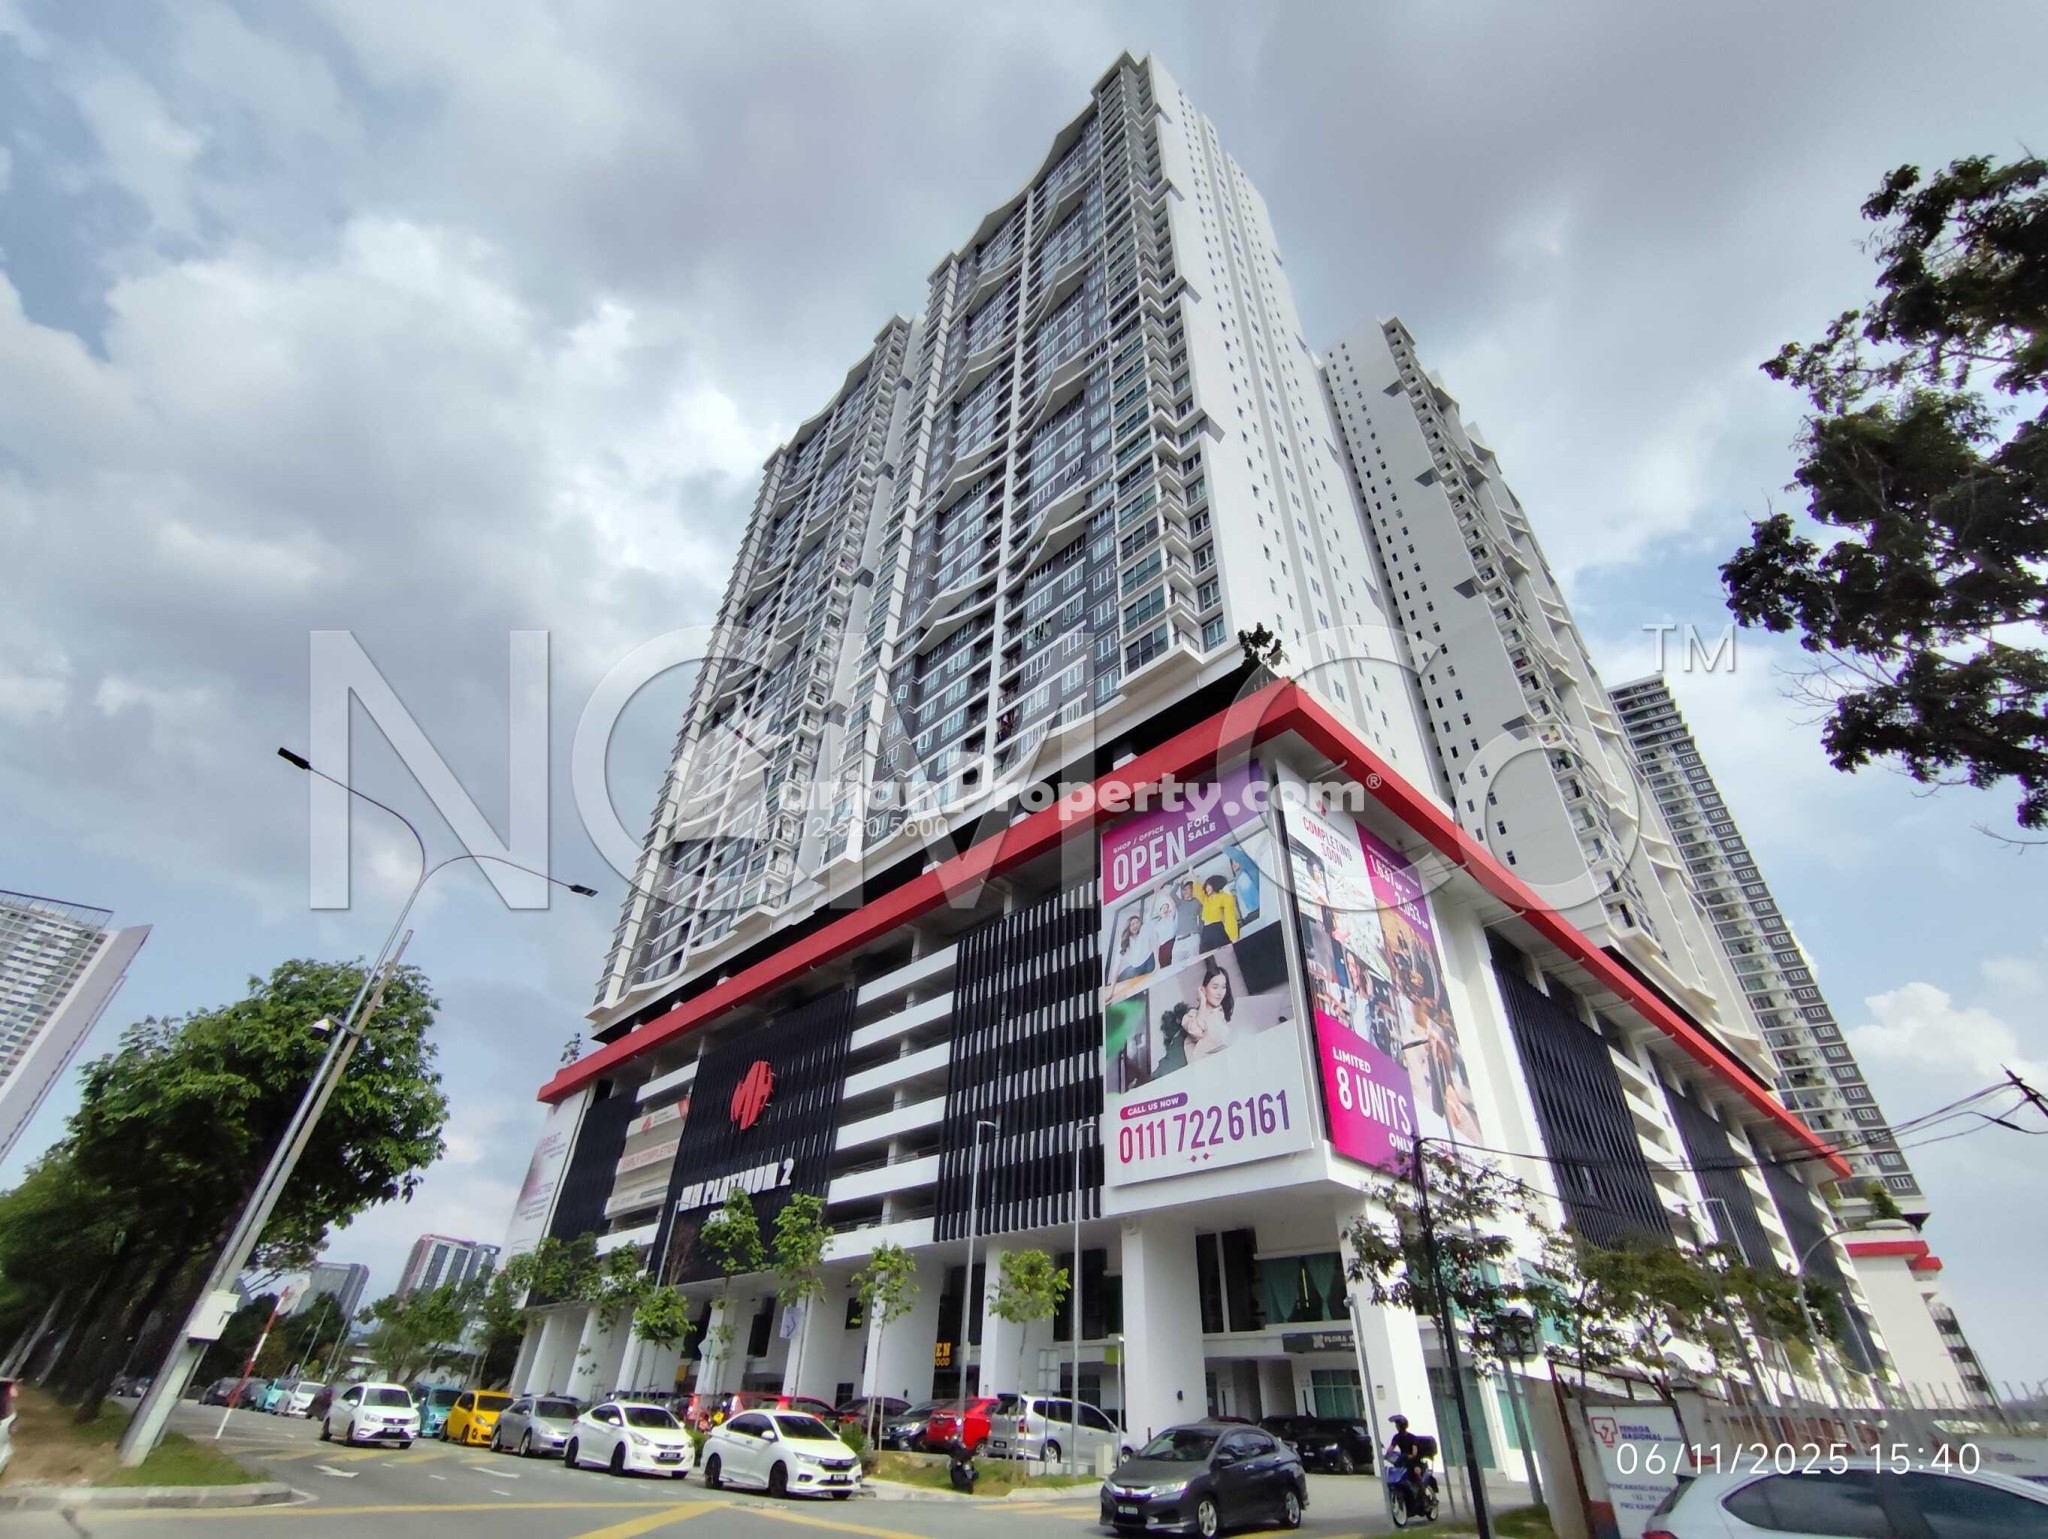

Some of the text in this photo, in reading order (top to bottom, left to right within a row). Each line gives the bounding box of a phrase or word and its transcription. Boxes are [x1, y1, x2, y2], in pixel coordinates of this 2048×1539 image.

[1187, 814, 1210, 831] FOR
[1187, 822, 1216, 842] SALE
[1113, 840, 1132, 854] SHOP
[1139, 825, 1164, 842] OFFICE
[1303, 816, 1352, 861] COMPLETING
[1113, 826, 1186, 891] OPEN
[1321, 842, 1343, 868] SOON
[1332, 1046, 1371, 1074] LIMITED
[1127, 1097, 1179, 1117] CALL US NOW
[1336, 1066, 1412, 1136] 8 UNITS
[1119, 1089, 1290, 1164] 0111 722 6161
[1389, 1132, 1414, 1153] ONLY
[779, 1158, 795, 1186] 2
[1618, 1425, 1650, 1433] TENAGA
[1622, 1432, 1661, 1441] NASIONAL
